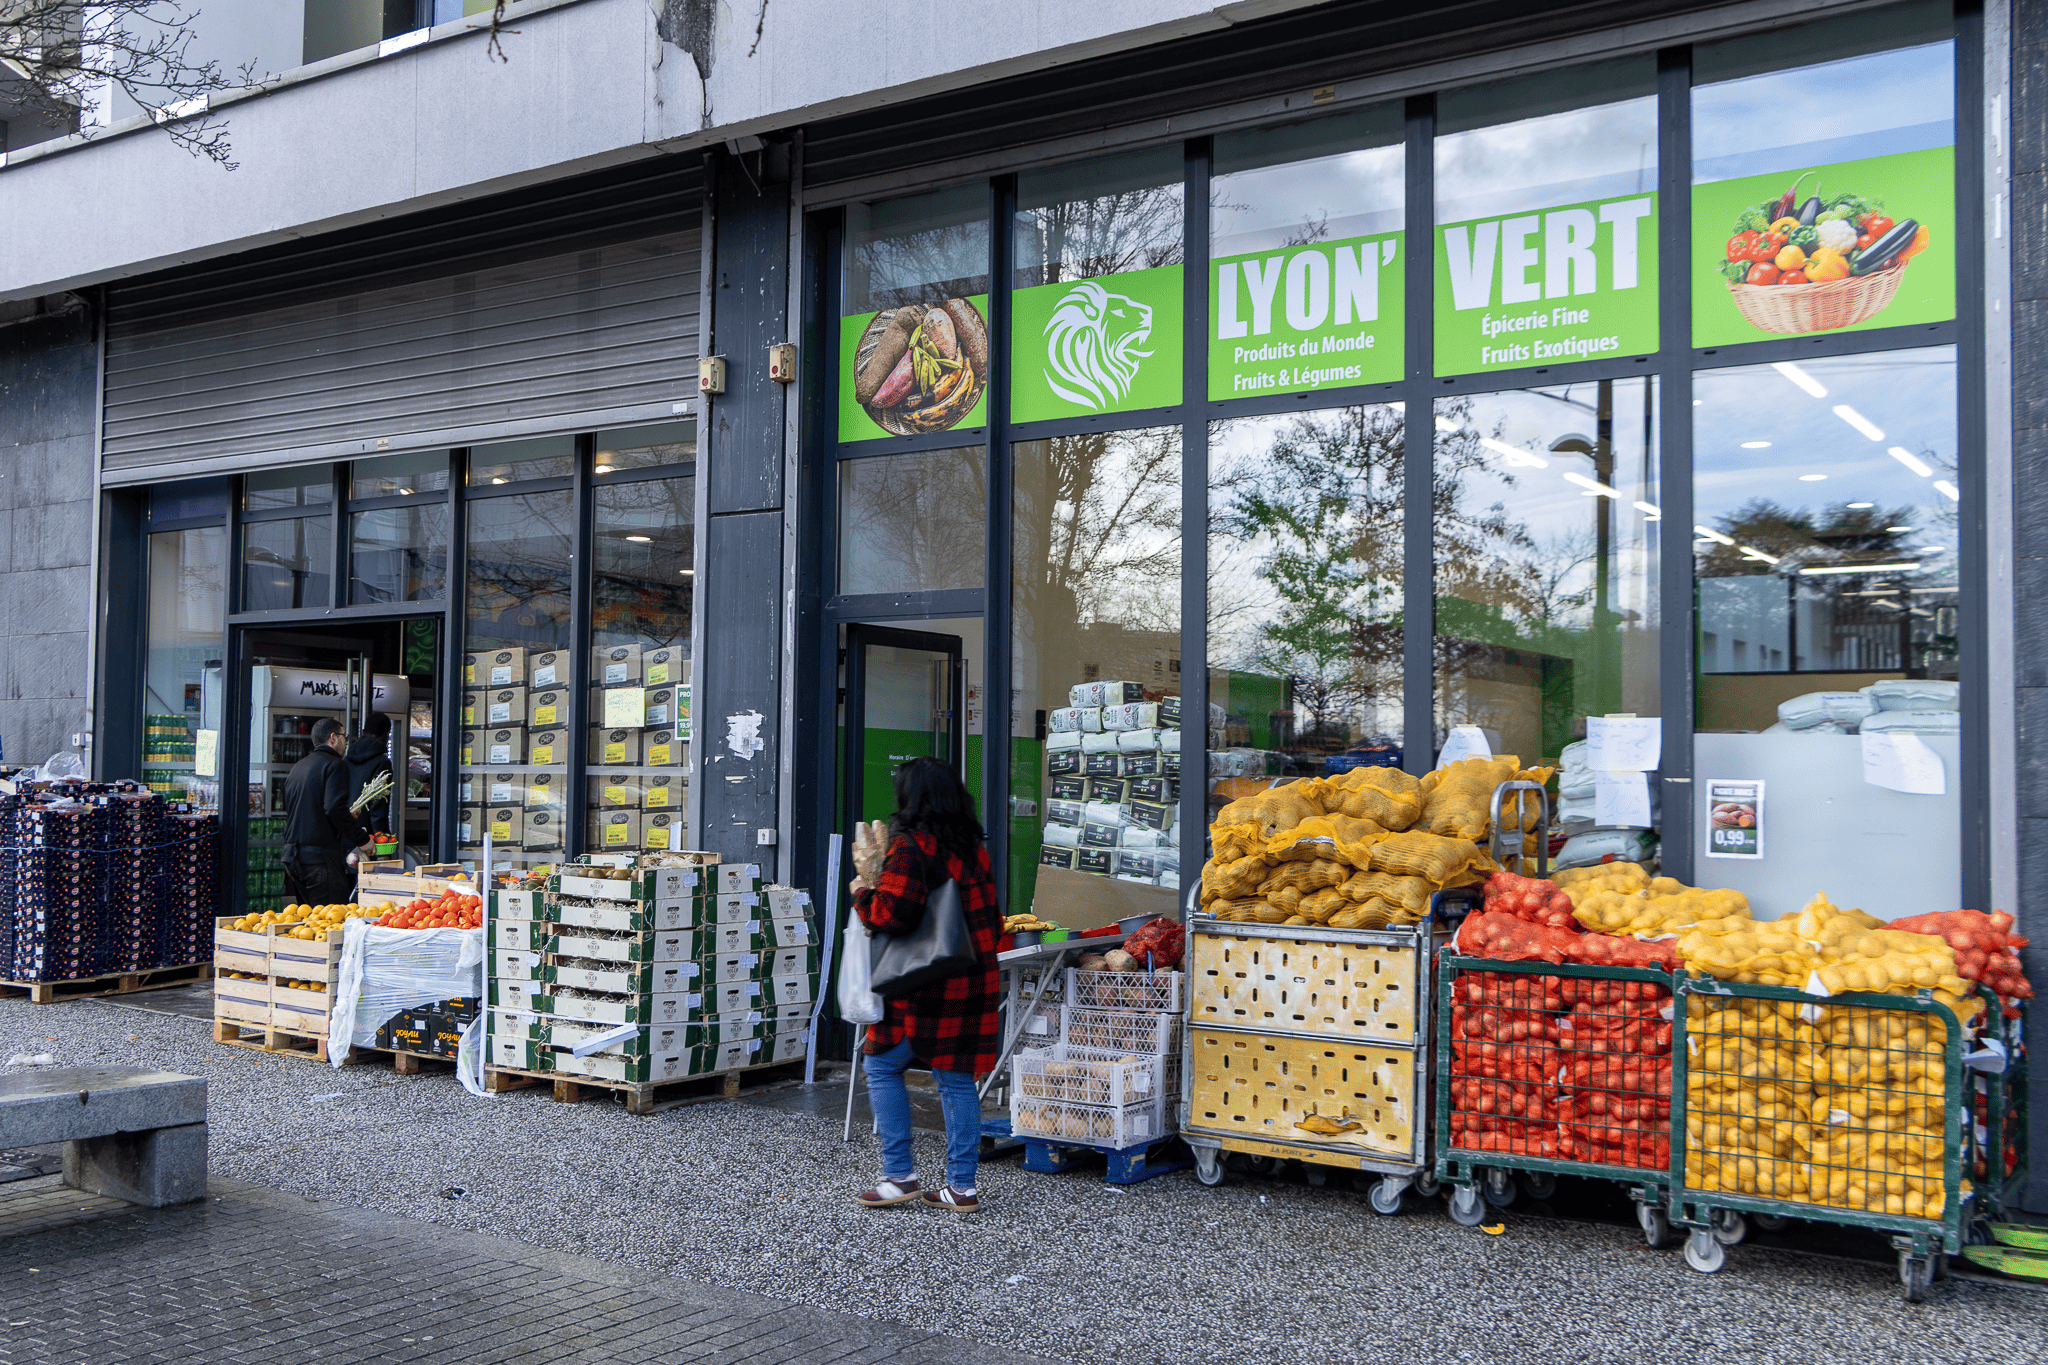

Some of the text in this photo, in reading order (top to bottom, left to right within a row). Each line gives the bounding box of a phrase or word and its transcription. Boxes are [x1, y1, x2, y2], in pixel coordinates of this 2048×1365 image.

[1444, 198, 1652, 311] VERT
[1482, 307, 1589, 339] Épicerie Fine
[1234, 332, 1374, 364] Produits du Monde
[1482, 334, 1618, 365] Fruits Exotiques
[1234, 362, 1361, 391] Fruits & Légumes
[1715, 830, 1745, 846] 0,99
